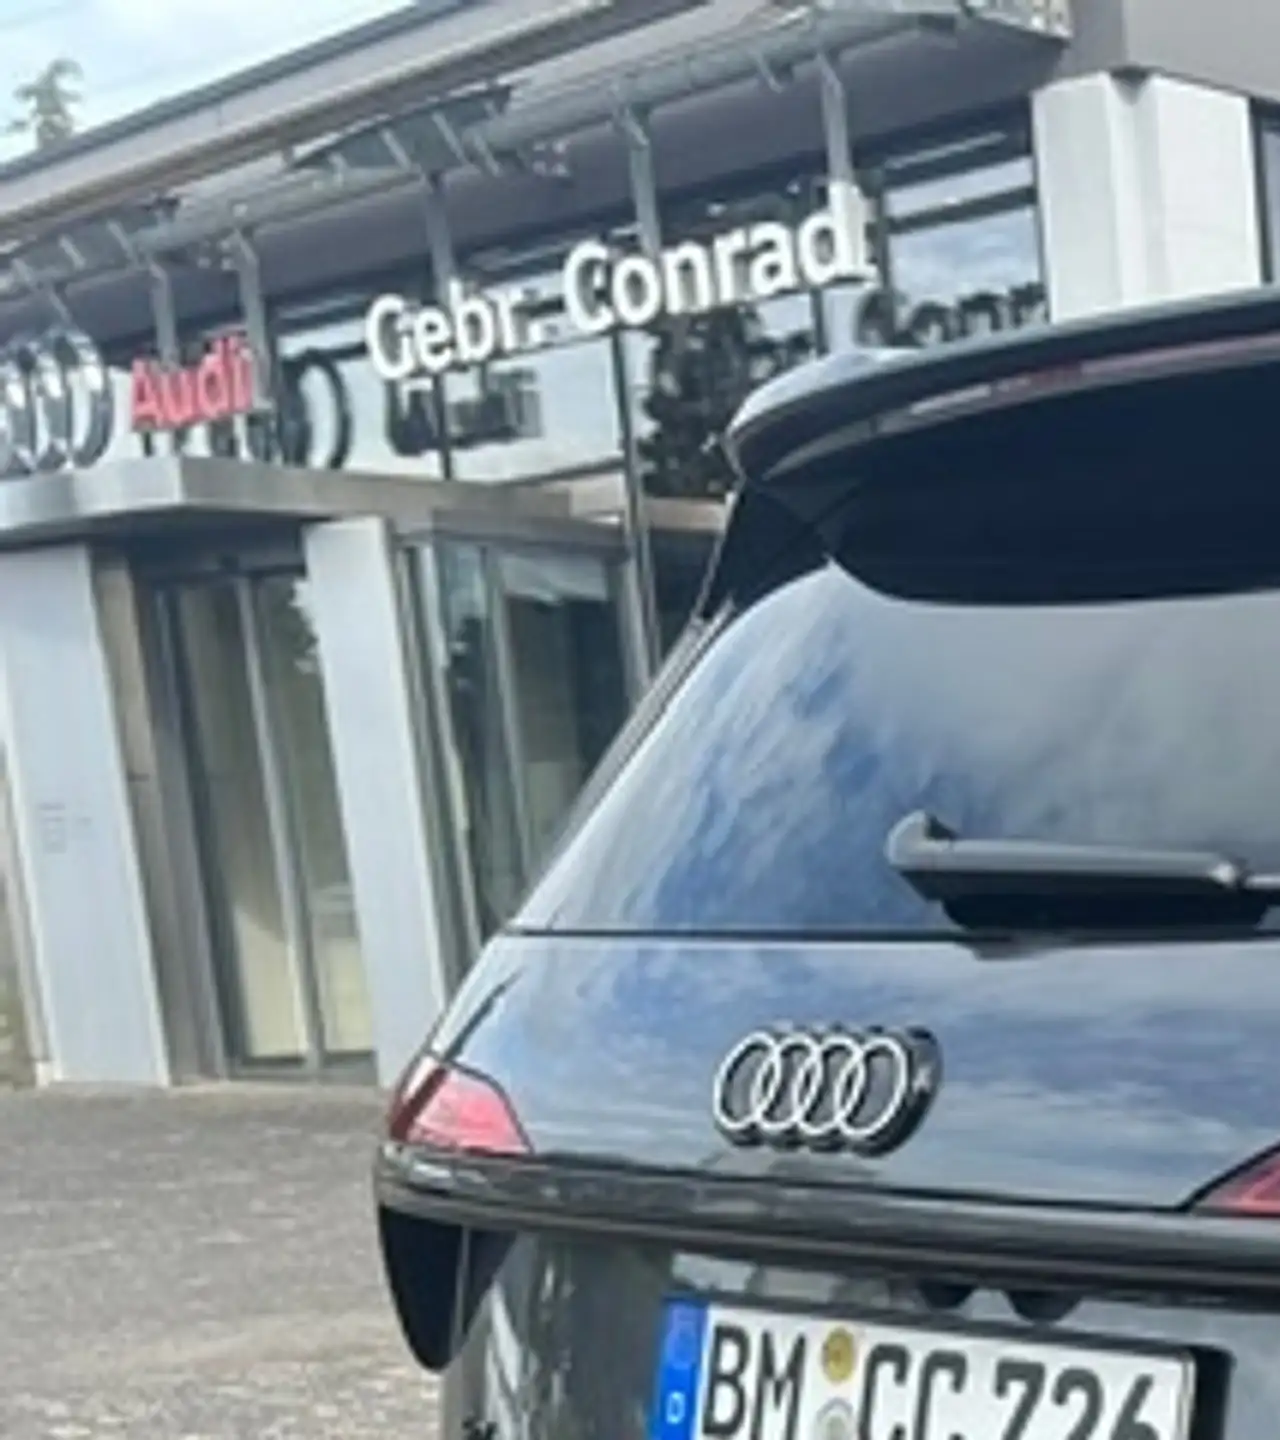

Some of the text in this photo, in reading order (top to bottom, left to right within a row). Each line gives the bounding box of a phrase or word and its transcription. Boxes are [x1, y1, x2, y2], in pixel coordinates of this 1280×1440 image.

[365, 180, 868, 379] Gebr. Conrad
[132, 336, 257, 428] Audi
